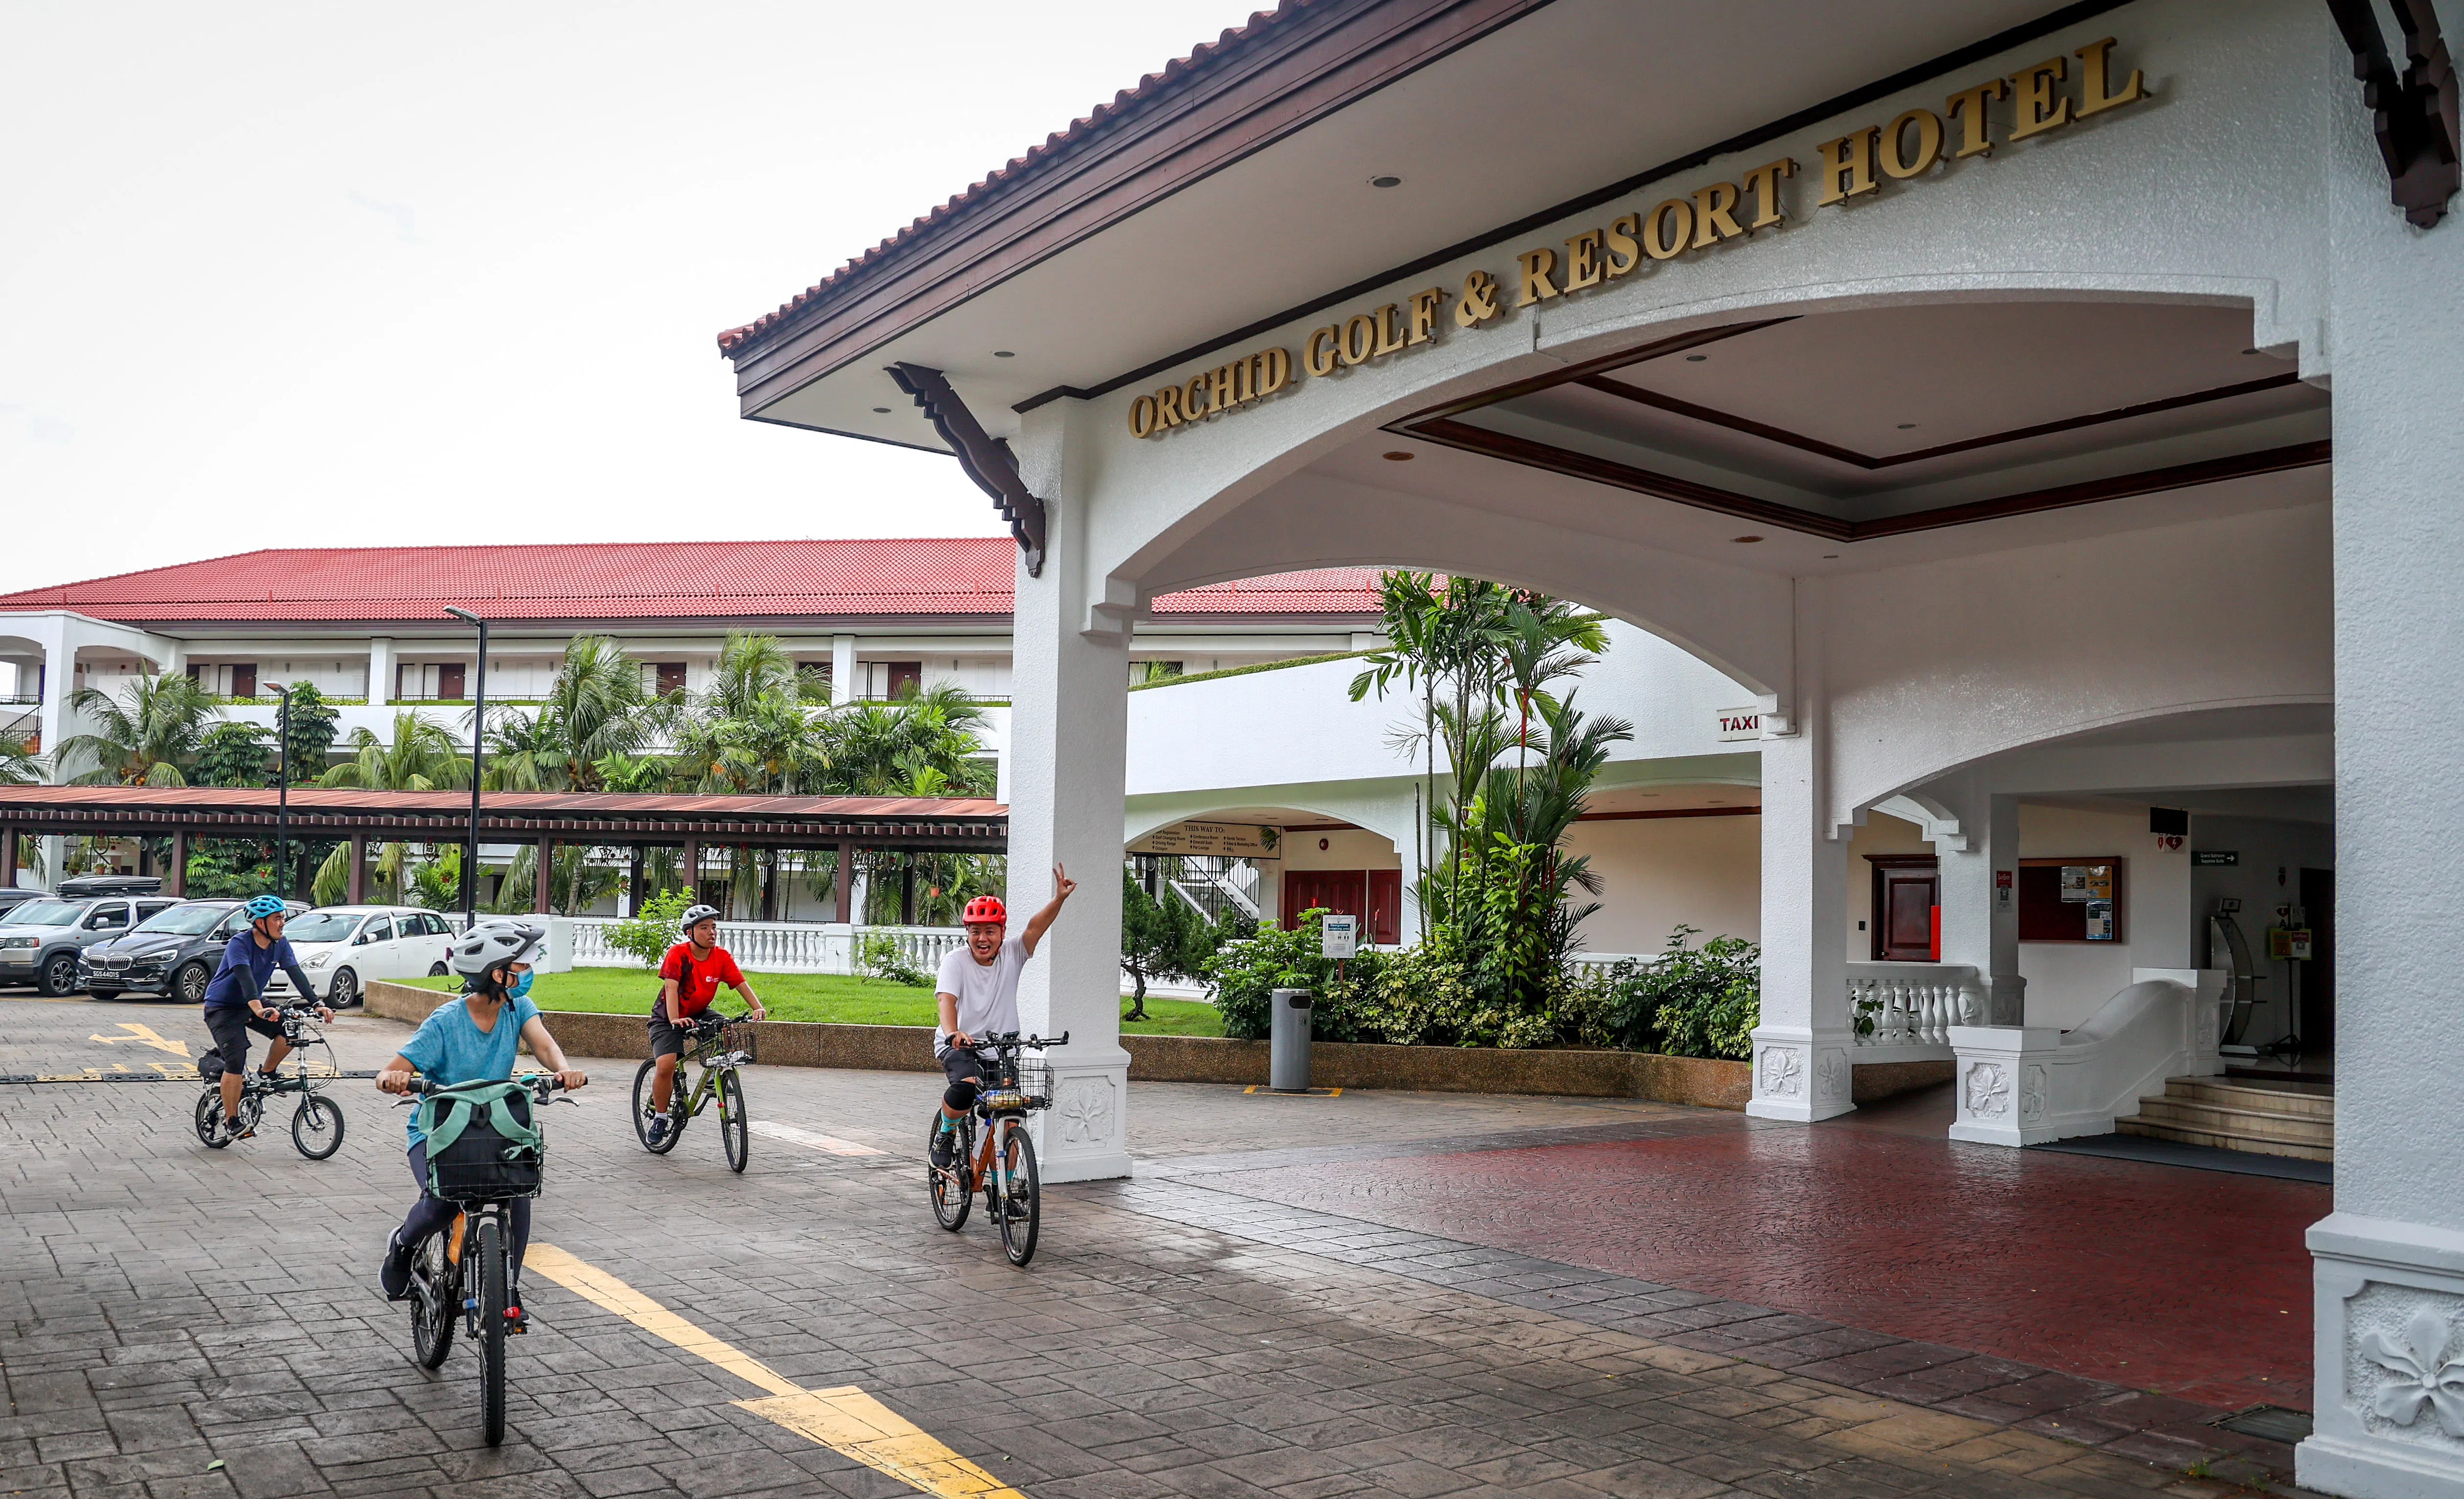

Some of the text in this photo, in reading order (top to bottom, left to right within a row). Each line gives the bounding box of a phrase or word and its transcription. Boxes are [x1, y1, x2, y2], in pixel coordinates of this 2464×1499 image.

[1128, 36, 2144, 439] ORCHID GOLF & RESORT HOTEL
[1719, 715, 1759, 731] TAXI
